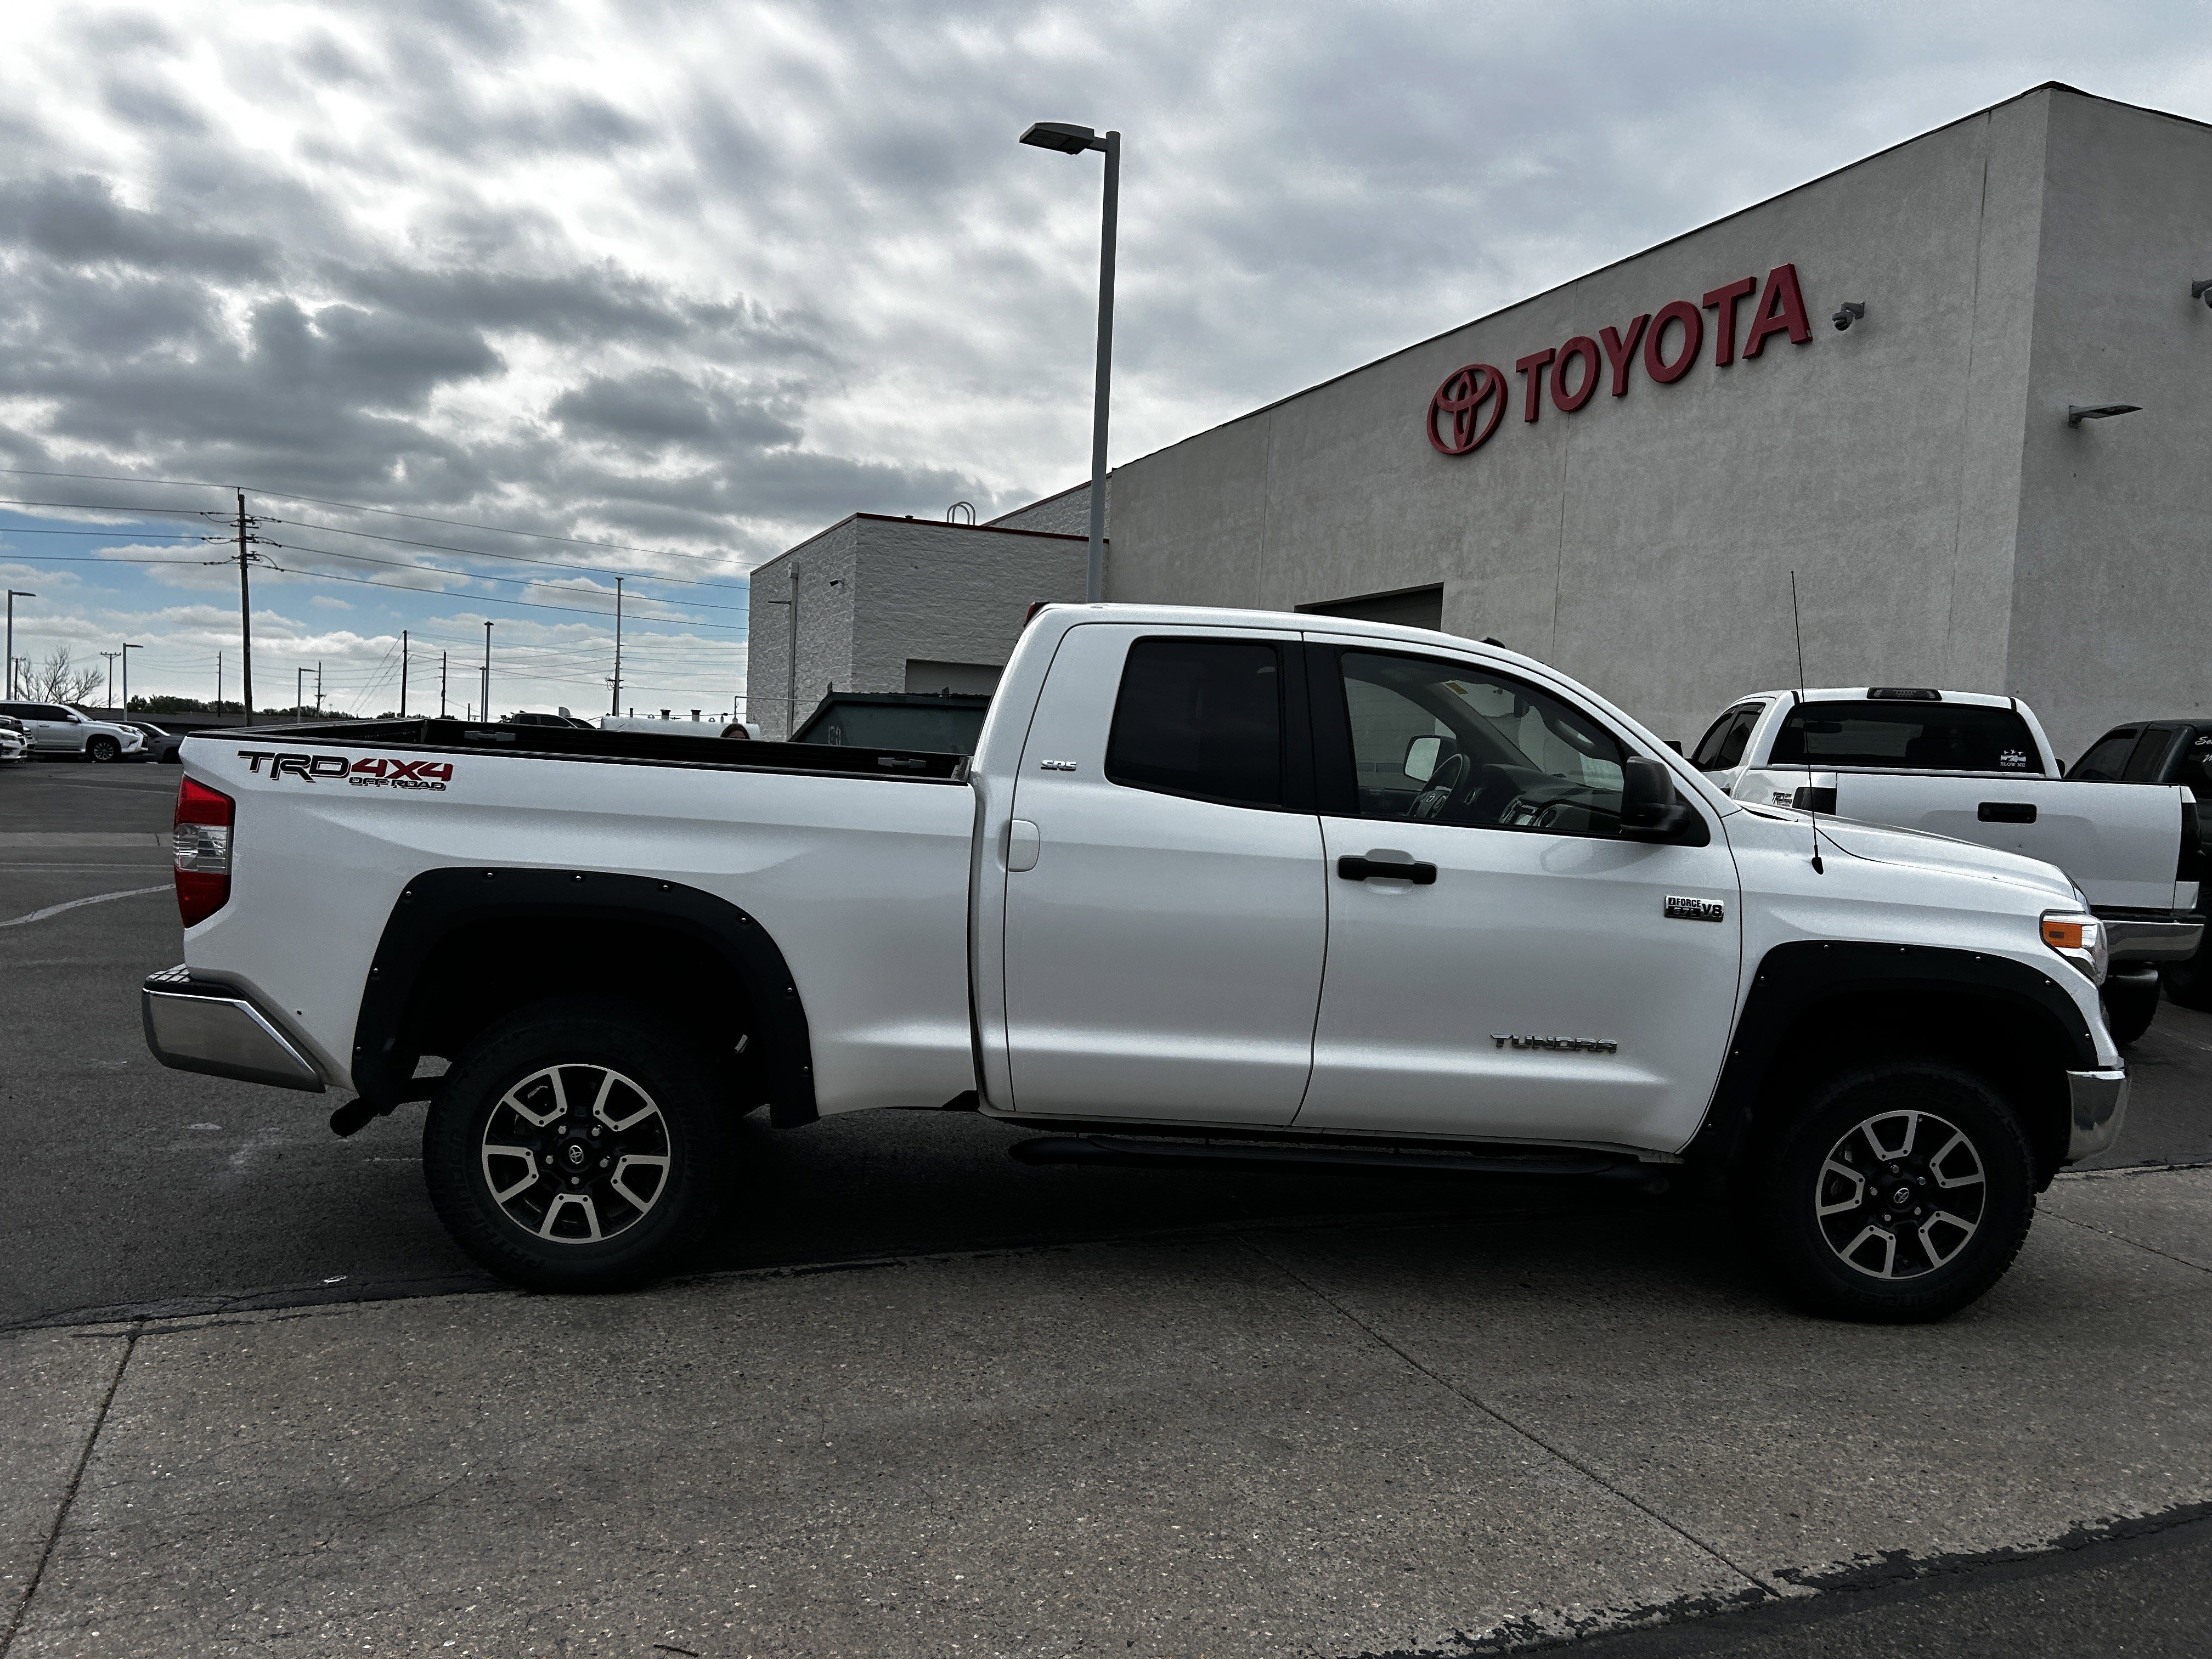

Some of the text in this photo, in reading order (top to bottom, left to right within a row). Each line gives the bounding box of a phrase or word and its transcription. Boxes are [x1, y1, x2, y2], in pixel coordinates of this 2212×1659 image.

[1516, 263, 1813, 423] TOYOTA
[238, 751, 351, 783] TRD
[1041, 760, 1077, 771] SR5
[349, 777, 446, 791] OFF ROAD
[1701, 903, 1723, 917] V8
[1491, 1033, 1618, 1053] TUNDRA
